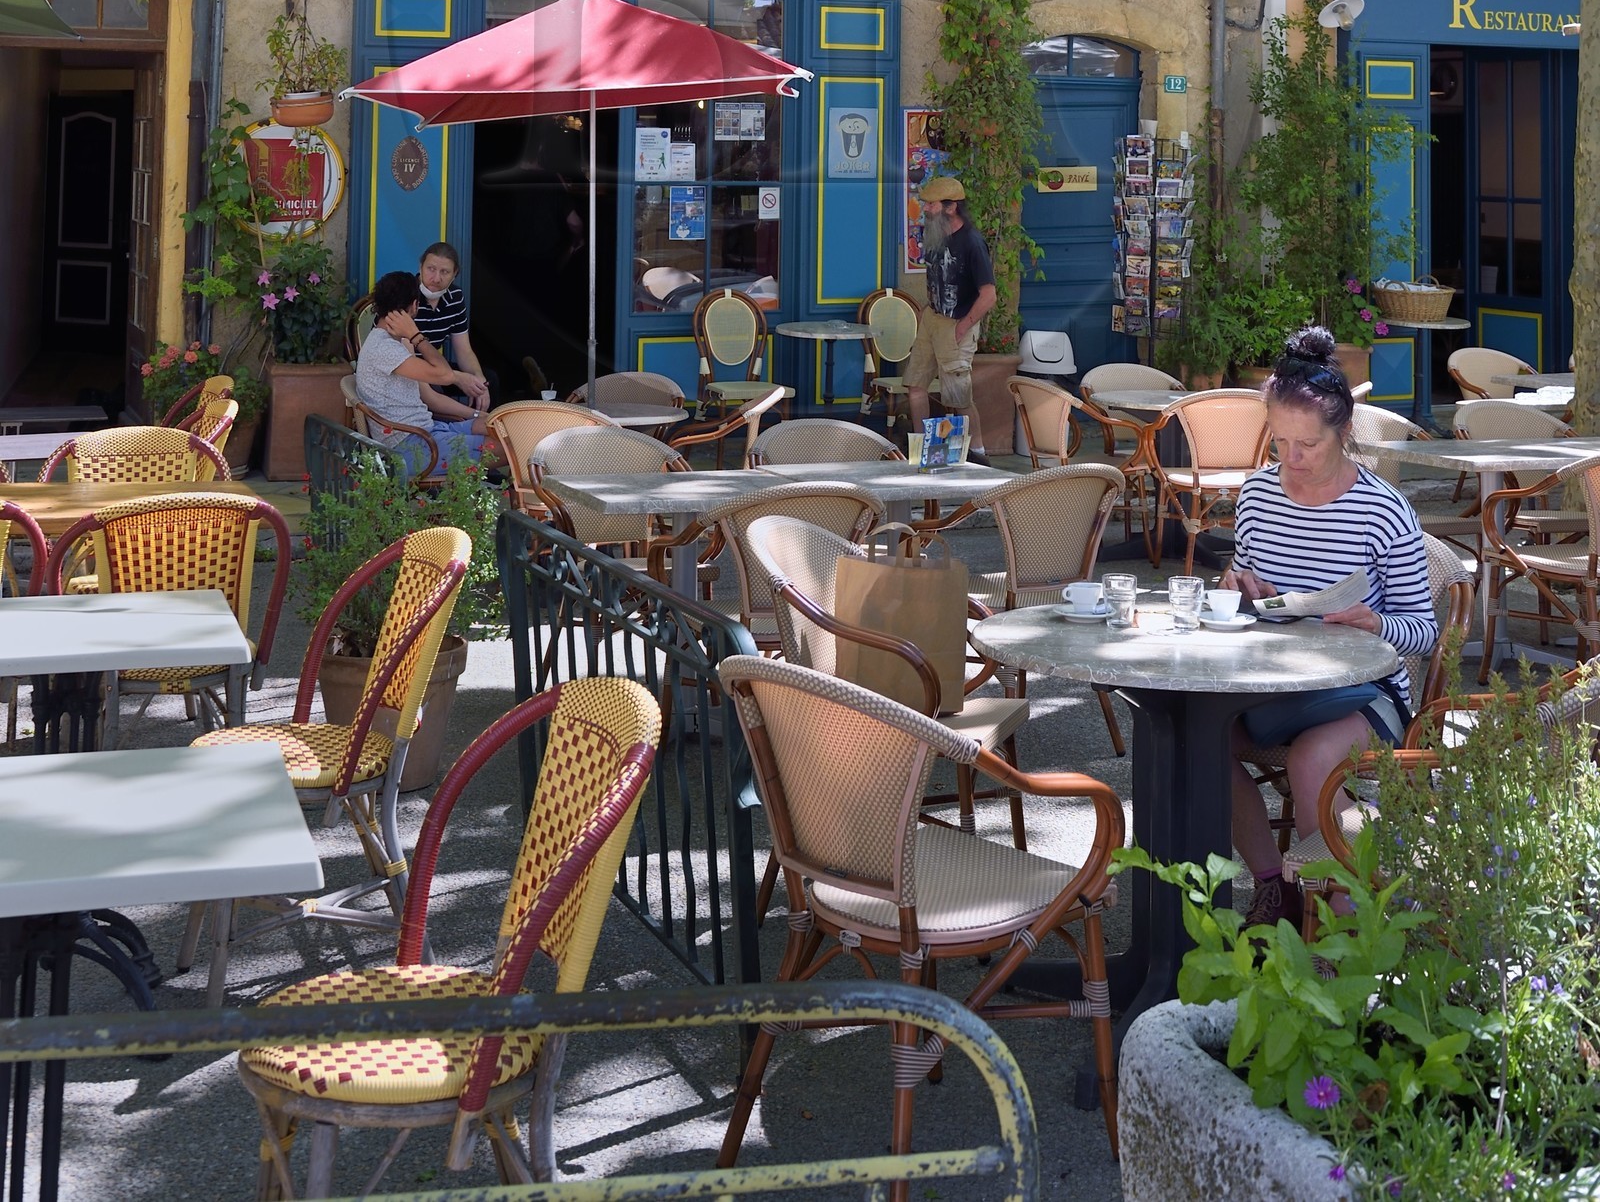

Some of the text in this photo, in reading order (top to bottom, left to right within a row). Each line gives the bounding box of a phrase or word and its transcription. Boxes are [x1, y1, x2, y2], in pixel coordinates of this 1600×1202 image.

[1169, 78, 1182, 90] 12
[404, 163, 416, 173] IV
[835, 161, 871, 170] JOKER
